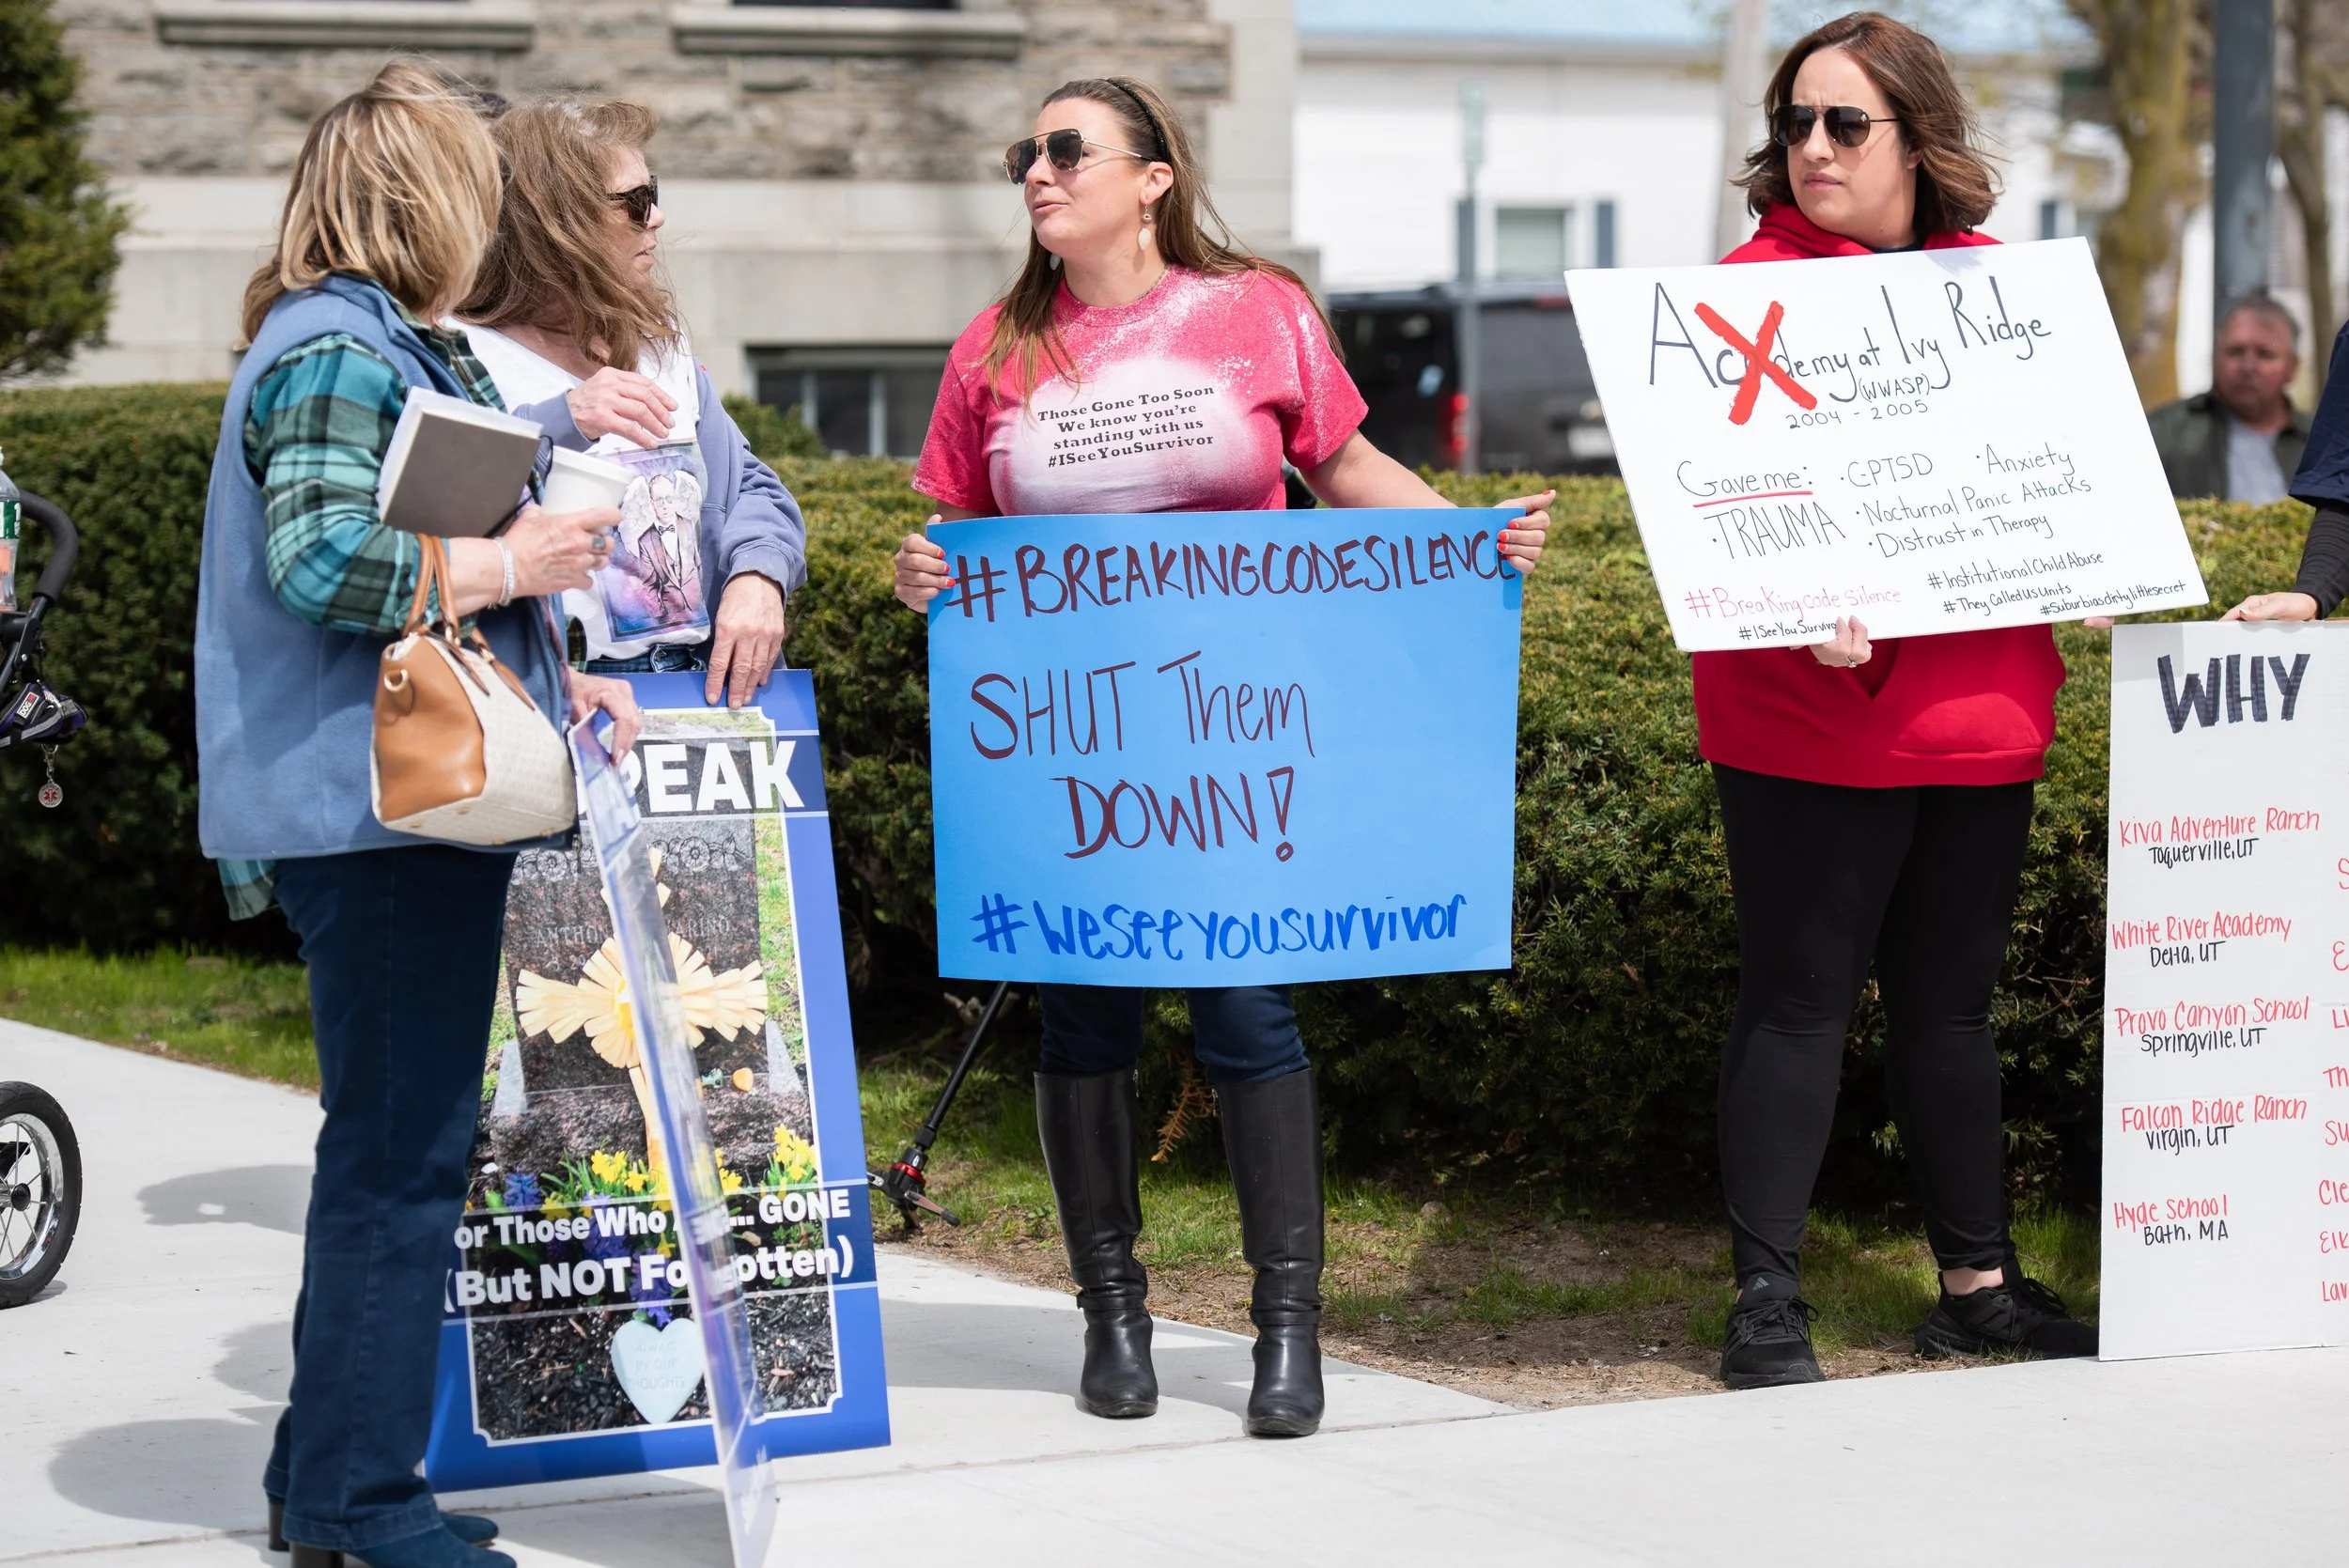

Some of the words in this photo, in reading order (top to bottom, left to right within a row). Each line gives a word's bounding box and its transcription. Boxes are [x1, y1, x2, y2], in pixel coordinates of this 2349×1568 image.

[1880, 285, 1951, 389] Ivy
[1944, 275, 2052, 361] Ridge
[1037, 406, 1087, 422] Those
[1091, 399, 1134, 412] Gone
[1138, 394, 1170, 405] Too
[1173, 387, 1214, 400] Soon
[1859, 373, 1931, 403] (WWASP)
[1057, 422, 1085, 433] We
[1089, 413, 1137, 428] know
[1785, 411, 1843, 429] 2004
[1871, 399, 1928, 420] 2005
[1048, 435, 1214, 468] #ISeeYouSurvivor
[1053, 429, 1134, 450] standing
[1139, 421, 1180, 436] with
[1184, 420, 1204, 430] us
[1985, 442, 2076, 476] Anxiety
[1862, 489, 1960, 527] Nocturnal
[1962, 486, 2012, 512] Panic
[1703, 501, 1846, 560] TRAUMA
[1875, 521, 1966, 558] Distrust
[1970, 527, 1984, 537] in
[1983, 515, 2054, 539] Therapy
[944, 530, 1517, 622] #BREAKINGCODESILENCE
[1739, 619, 1836, 641] #ISeeYouSurvivo
[971, 660, 1136, 759] SHUT
[1157, 649, 1315, 758] Them
[2157, 654, 2310, 734] WHY
[576, 739, 805, 815] EAK
[1049, 766, 1294, 862] DOWN!
[2170, 815, 2257, 842] Adventure
[2265, 807, 2320, 832] Ranch
[2112, 919, 2162, 950] White
[2166, 916, 2209, 940] River
[2213, 910, 2292, 941] Academy
[2150, 945, 2194, 968] Delta,
[2200, 940, 2226, 962] UT
[2114, 1007, 2167, 1037] Provo
[2174, 1001, 2246, 1031] Canyon
[2252, 996, 2310, 1023] School
[2140, 1028, 2236, 1058] Springville,
[2240, 1027, 2267, 1048] UT
[2122, 1105, 2183, 1133] Falcon
[2192, 1098, 2245, 1126] Ridge
[2254, 1094, 2307, 1124] Ranch
[2206, 1125, 2235, 1146] UT
[493, 1216, 590, 1246] Those
[594, 1205, 667, 1237] Who
[758, 1189, 851, 1224] GONE
[2114, 1201, 2159, 1233] Hyde
[2144, 1223, 2191, 1247] Bath,
[2199, 1219, 2230, 1241] MA
[539, 1257, 632, 1299] NOT
